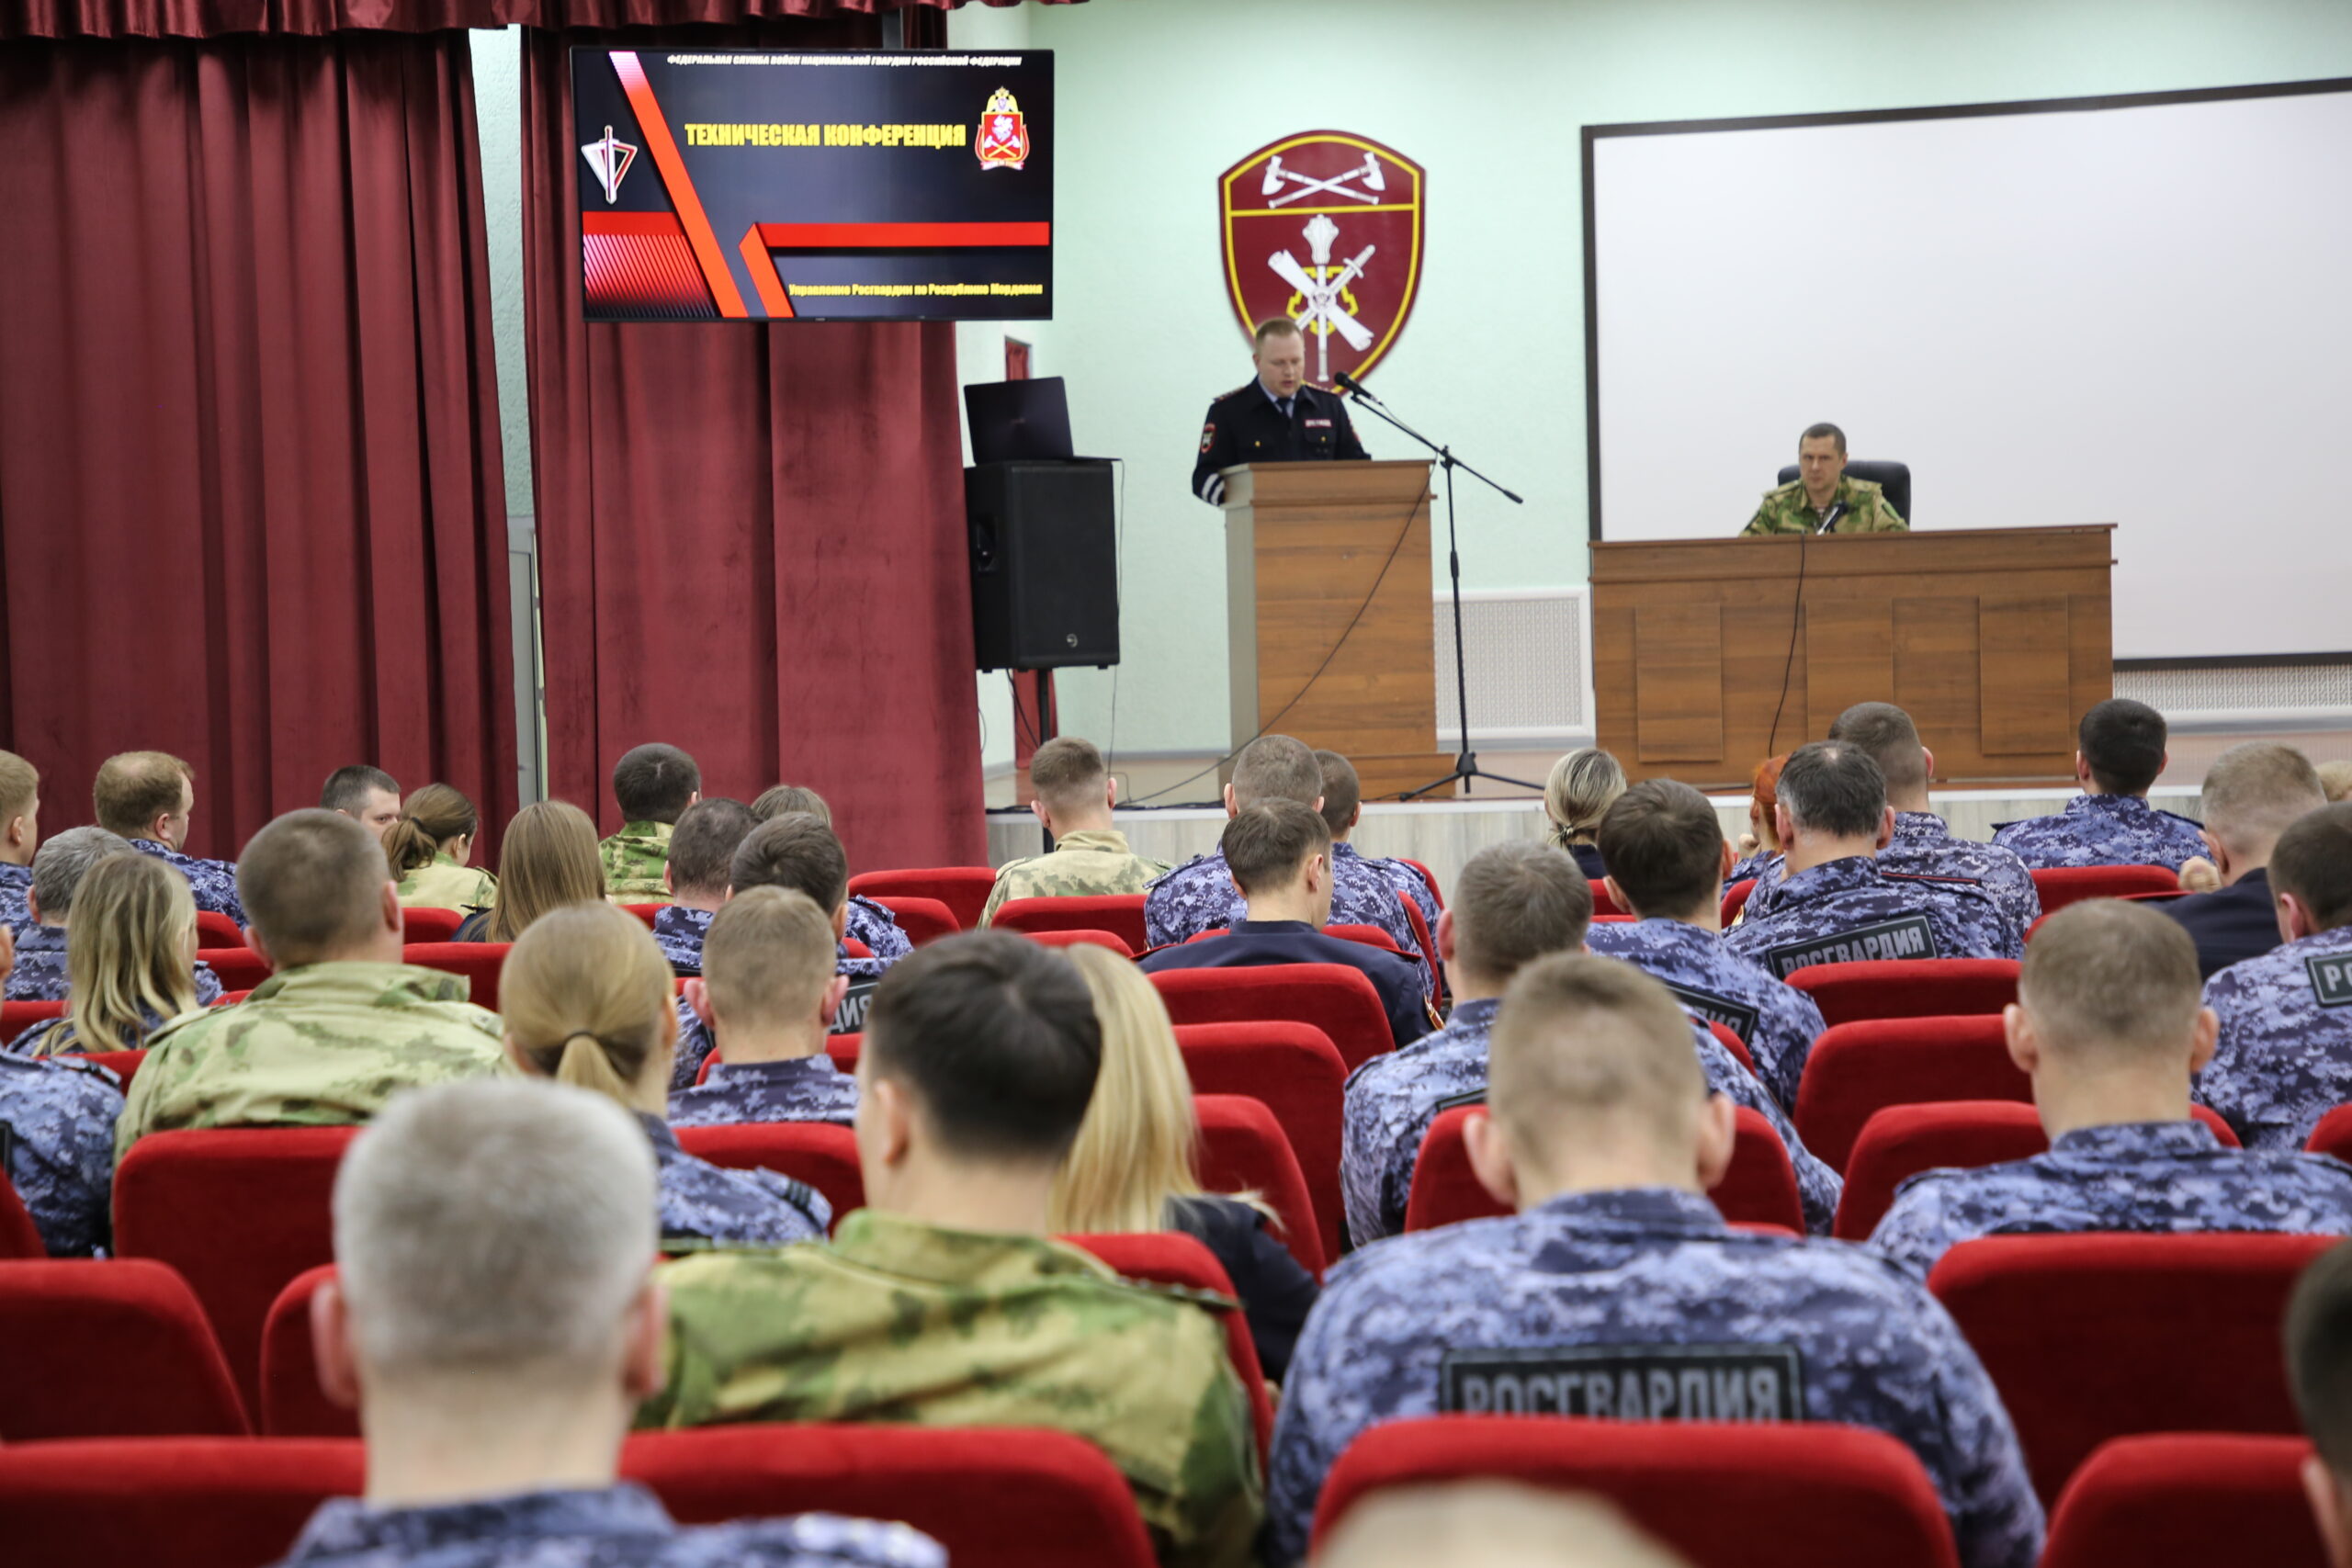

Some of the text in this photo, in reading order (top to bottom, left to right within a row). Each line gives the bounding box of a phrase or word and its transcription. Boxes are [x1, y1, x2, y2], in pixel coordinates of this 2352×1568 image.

[667, 54, 1022, 67] ФЕДЕРАЛЬНАЯ СЛУЖБА ВОЙСК НАЦИОНАЛЬНОЙ ГВАРДИИ РОССИЙСКОЙ ФЕДЕРАЦИИ
[684, 123, 967, 150] ТЕХНИЧЕСКАЯ КОНФЕРЕНЦИЯ
[788, 283, 1043, 297] Управление Росгвардии по Республике Мордовия
[1462, 1367, 1781, 1422] РОСГВАРДИЯ
